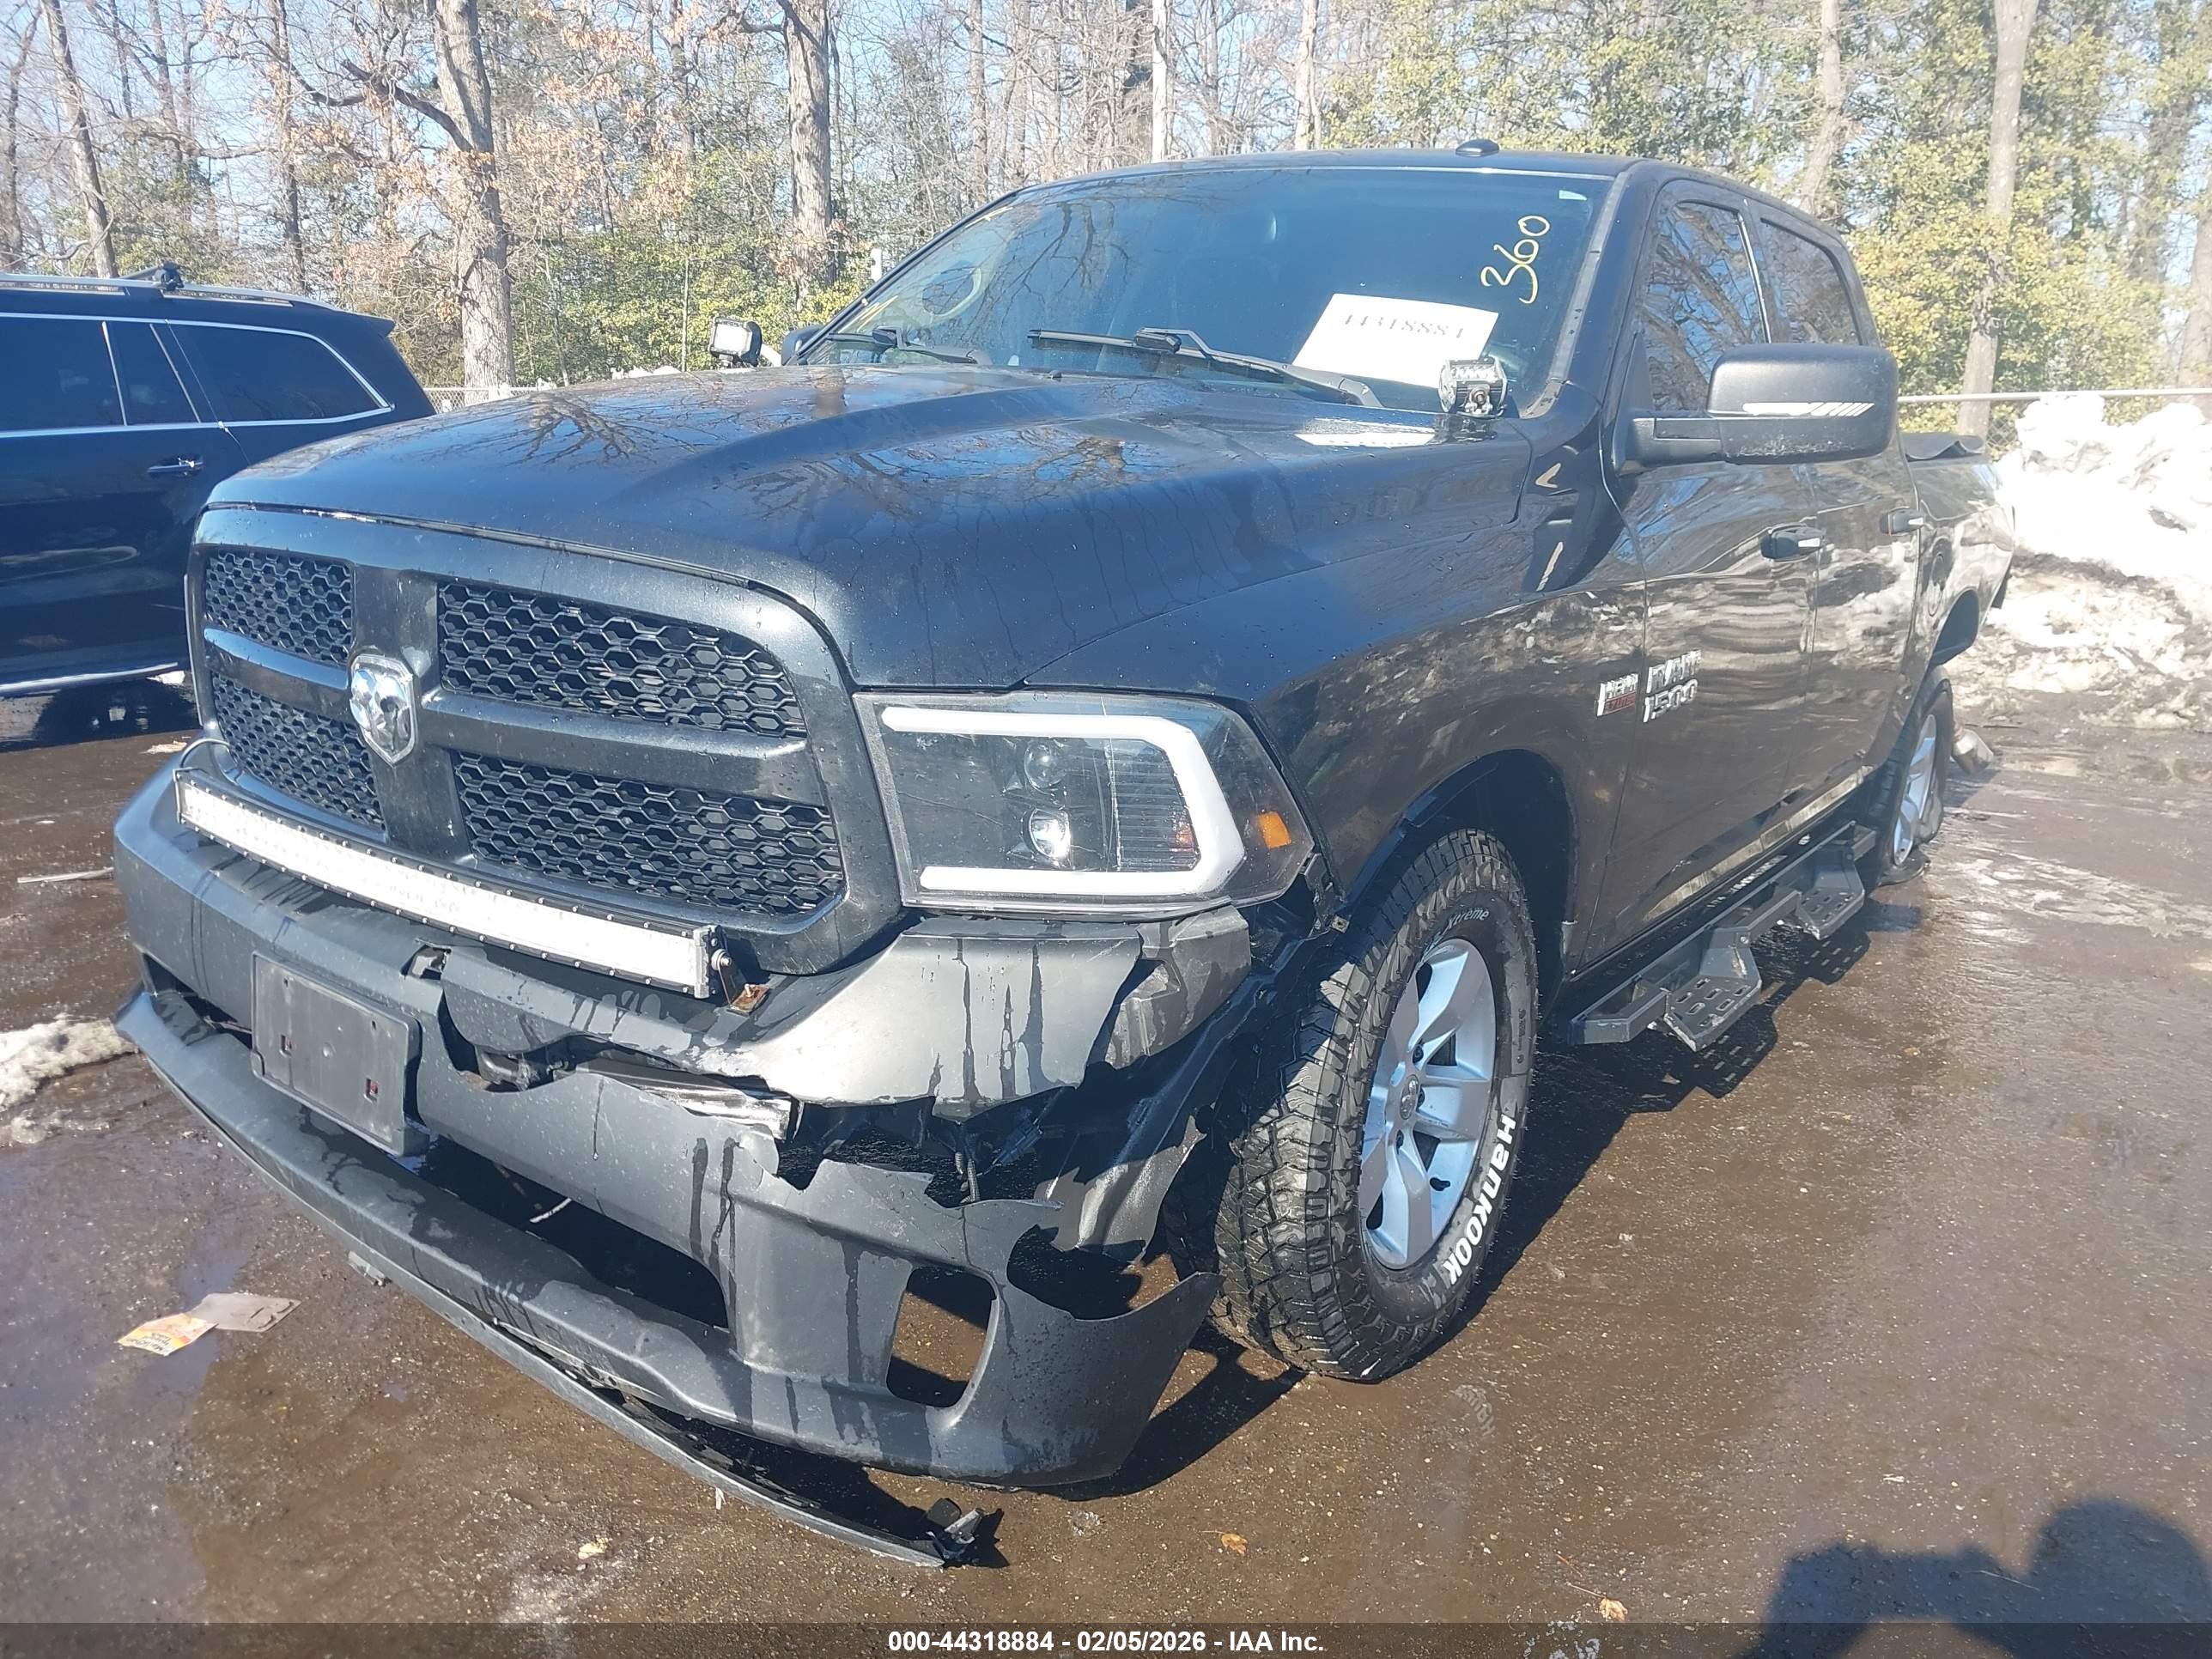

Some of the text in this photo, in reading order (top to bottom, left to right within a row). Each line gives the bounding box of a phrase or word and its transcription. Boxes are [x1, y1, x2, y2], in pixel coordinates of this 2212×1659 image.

[1480, 215, 1550, 304] 360
[1646, 650, 1701, 693] RAM
[1643, 679, 1698, 723] 1500
